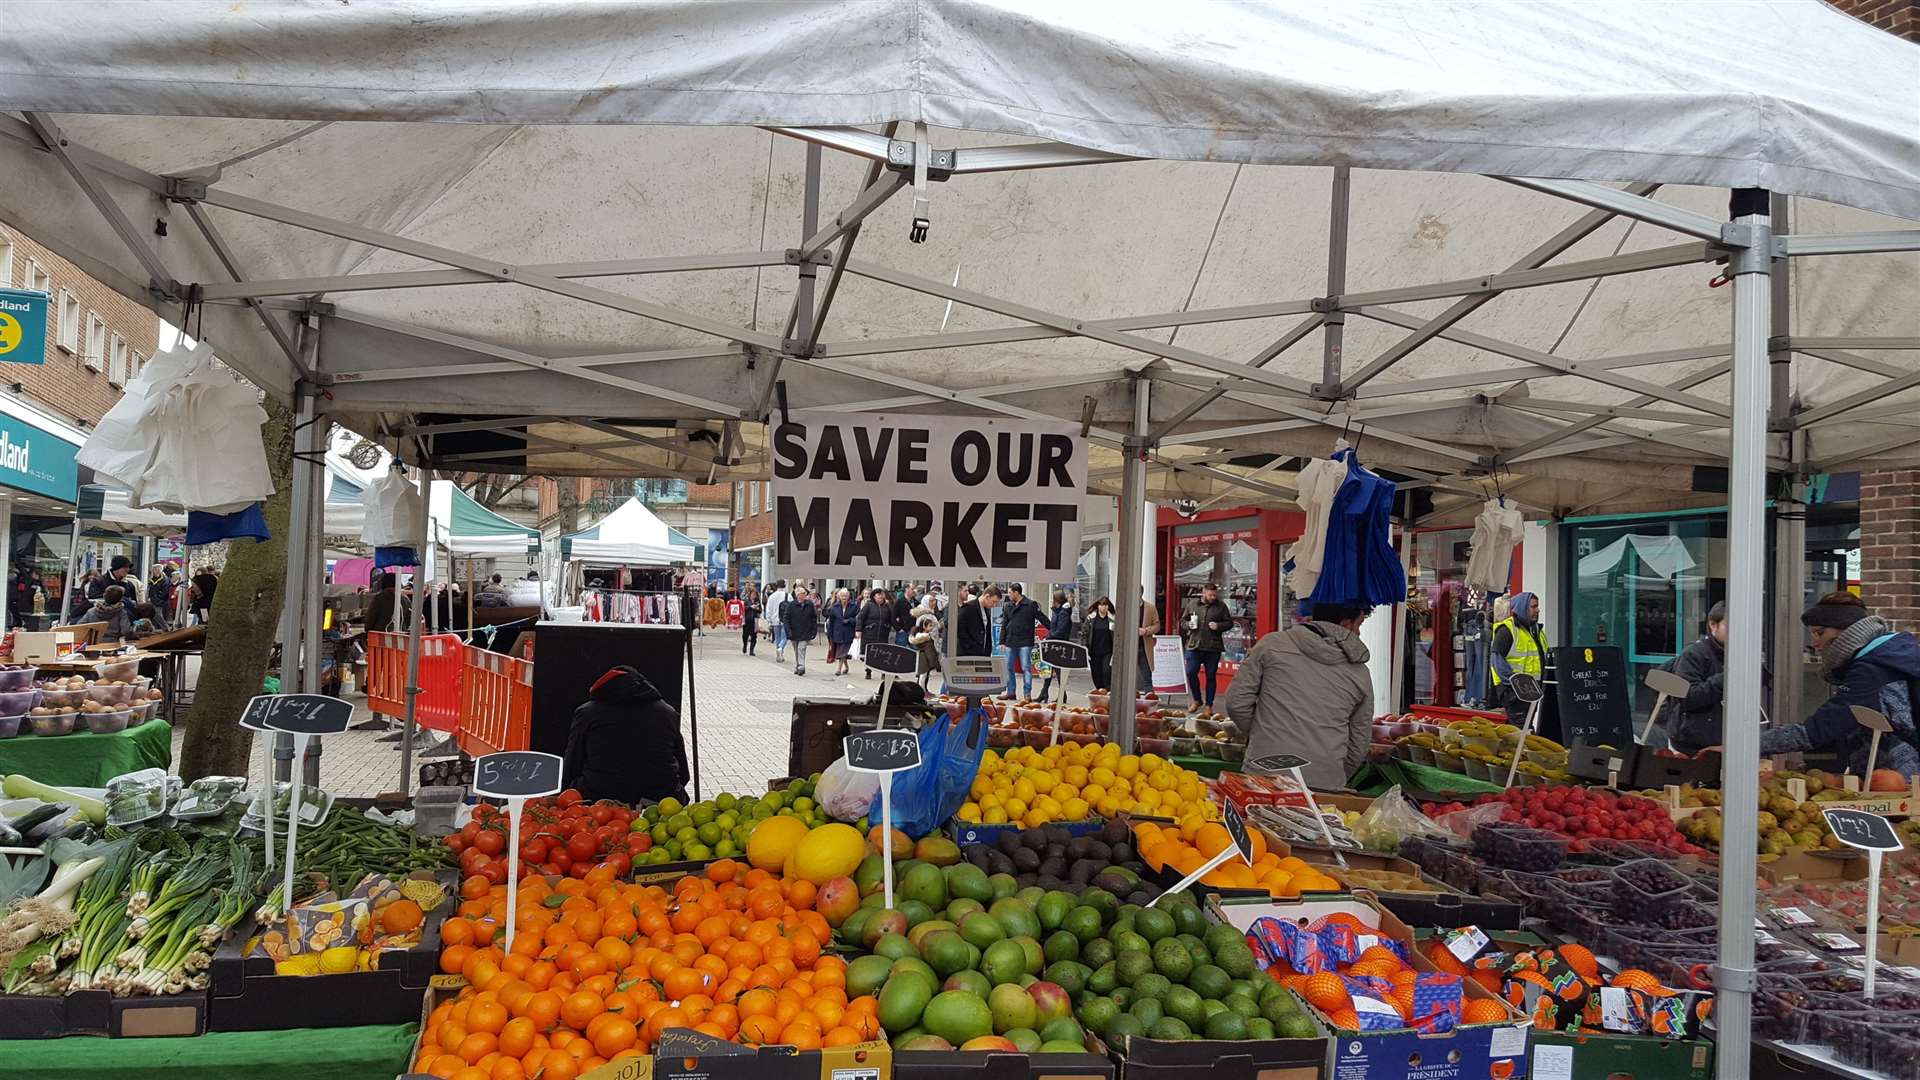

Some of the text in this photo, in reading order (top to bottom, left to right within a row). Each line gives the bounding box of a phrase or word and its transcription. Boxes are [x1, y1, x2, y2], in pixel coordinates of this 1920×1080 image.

[773, 422, 1075, 487] SAVE OUR
[777, 496, 1077, 570] MARKET
